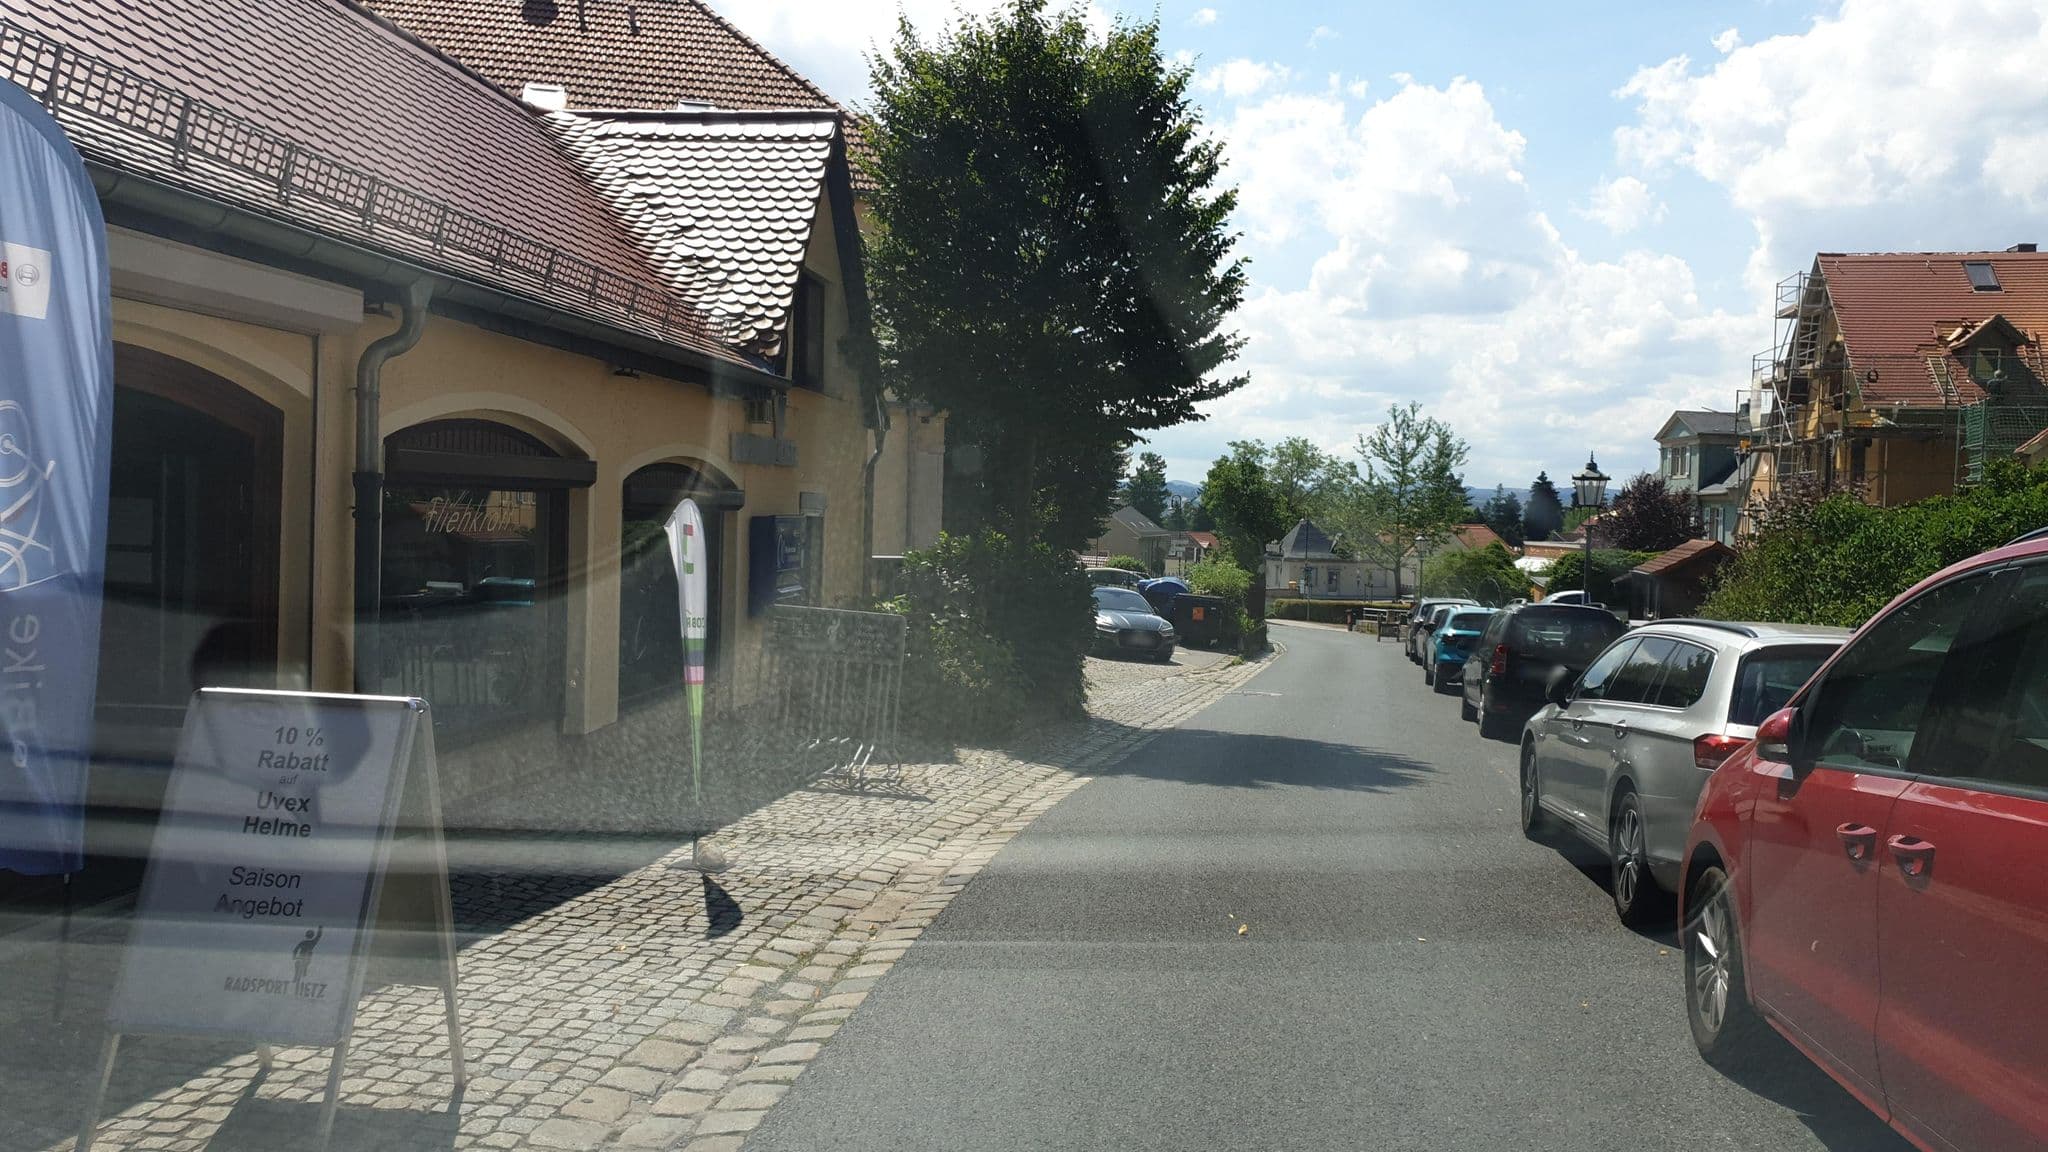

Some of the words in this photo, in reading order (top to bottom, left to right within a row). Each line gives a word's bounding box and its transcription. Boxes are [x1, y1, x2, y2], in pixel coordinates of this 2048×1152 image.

[275, 726, 299, 745] 10
[305, 727, 325, 746] %
[257, 750, 329, 772] Rabatt
[279, 774, 299, 785] auf
[257, 791, 311, 812] Uvex
[242, 815, 312, 838] Helme
[228, 865, 302, 889] Saison
[213, 893, 304, 920] Angebot
[223, 976, 291, 995] RADSPORT
